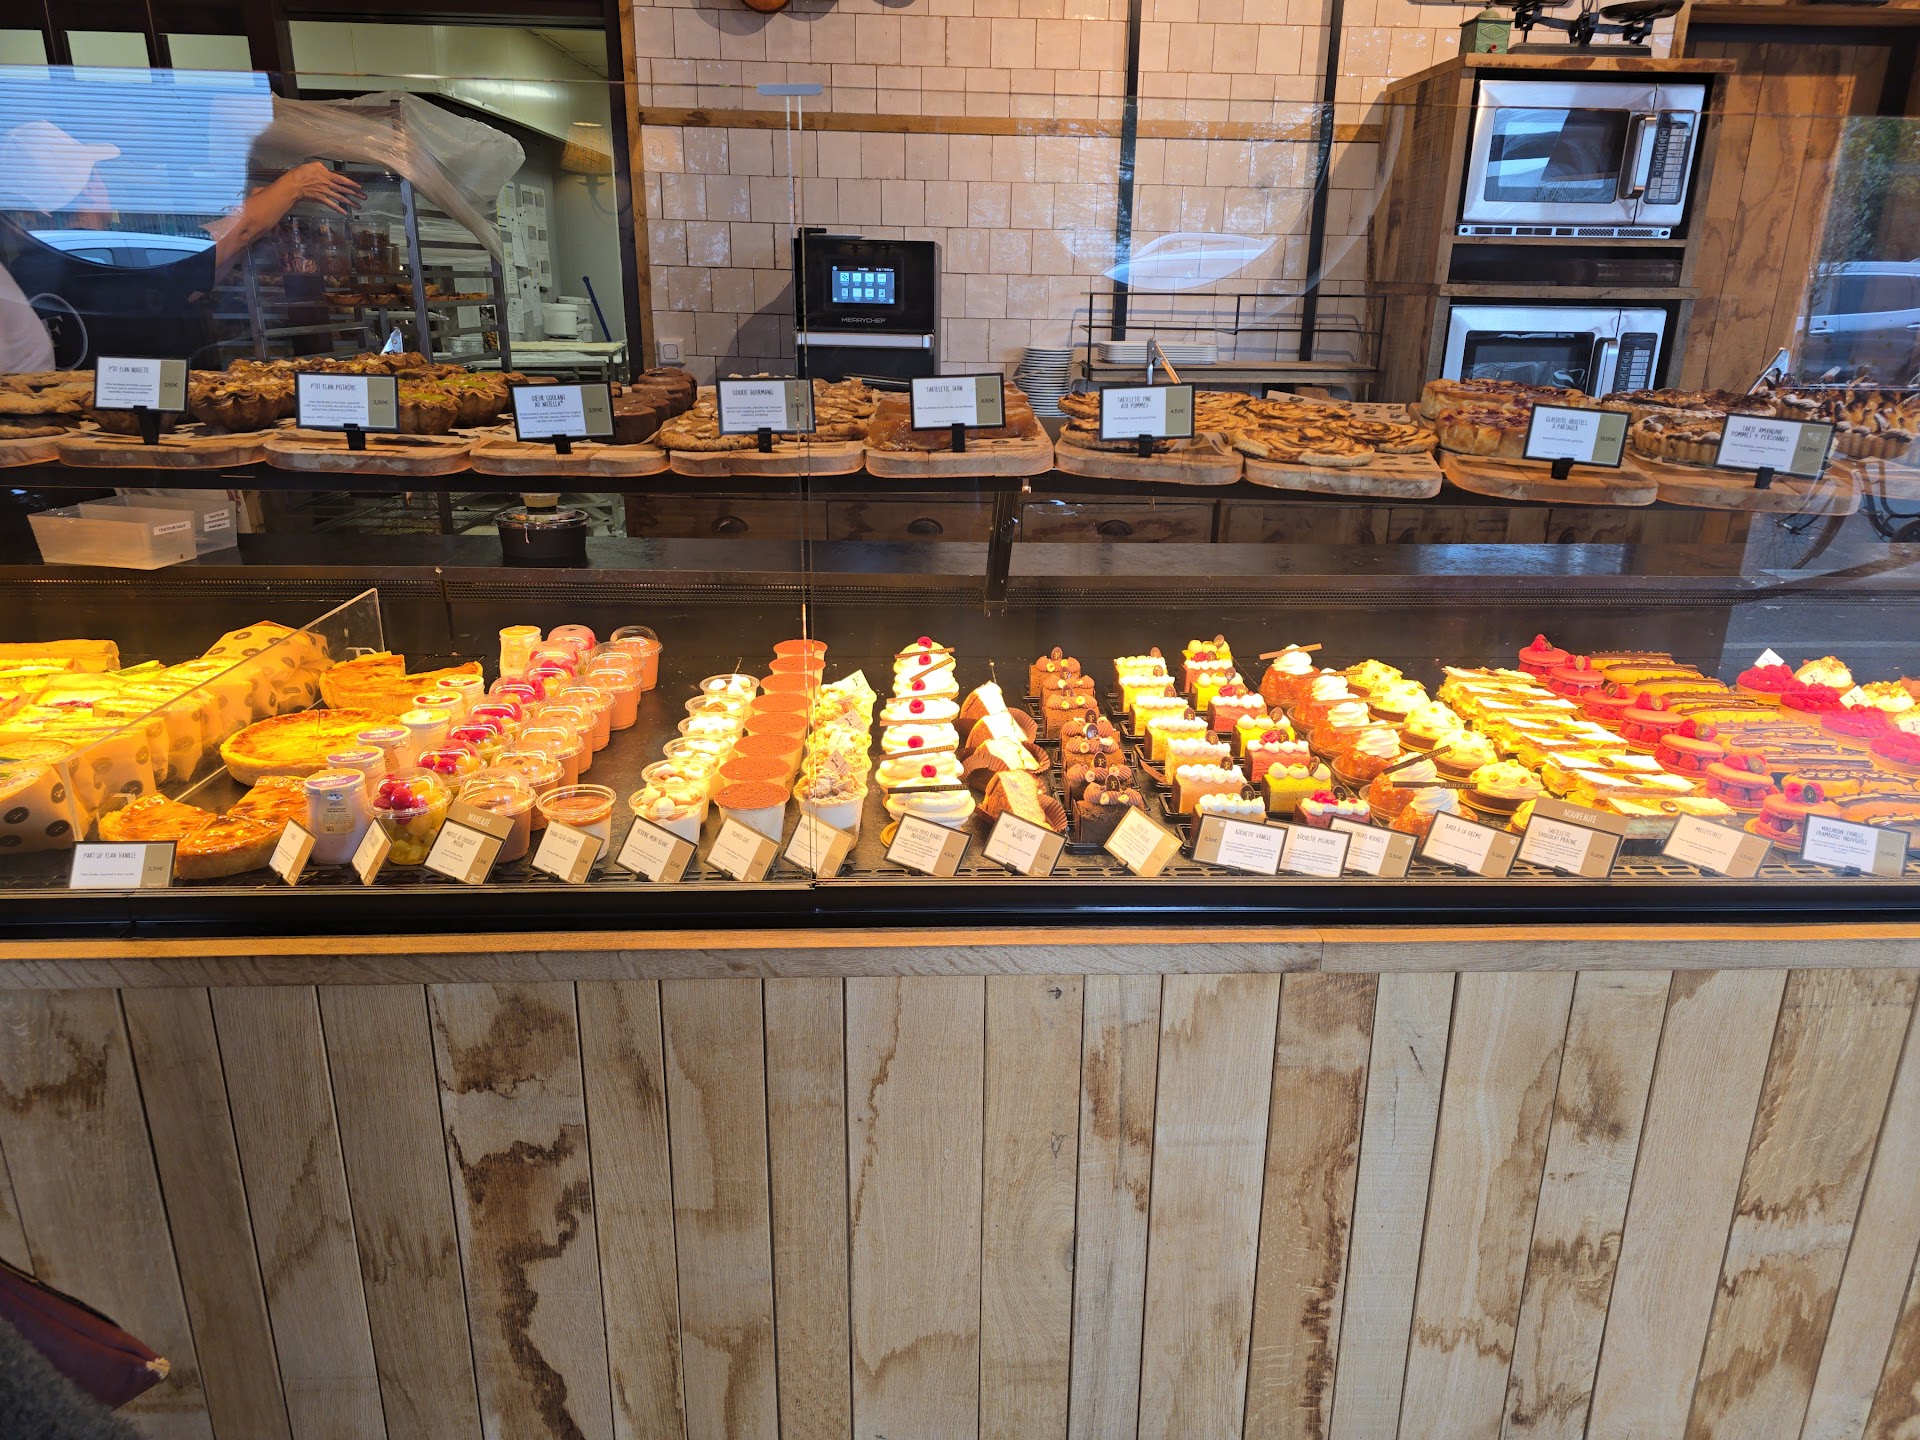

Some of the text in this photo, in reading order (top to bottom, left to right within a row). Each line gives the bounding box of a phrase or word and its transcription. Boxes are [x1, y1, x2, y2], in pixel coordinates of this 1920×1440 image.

[1759, 427, 1784, 435] AMANDINE
[1761, 434, 1789, 442] PERSONNES
[1564, 809, 1597, 823] NOUVEAUTÉ
[1468, 829, 1482, 839] CRÈME
[1539, 832, 1560, 841] CHOCOLAT
[1816, 831, 1840, 840] FRAMBOISE
[1821, 826, 1863, 838] MACARON VANILLE
[1256, 833, 1272, 841] VANILLE
